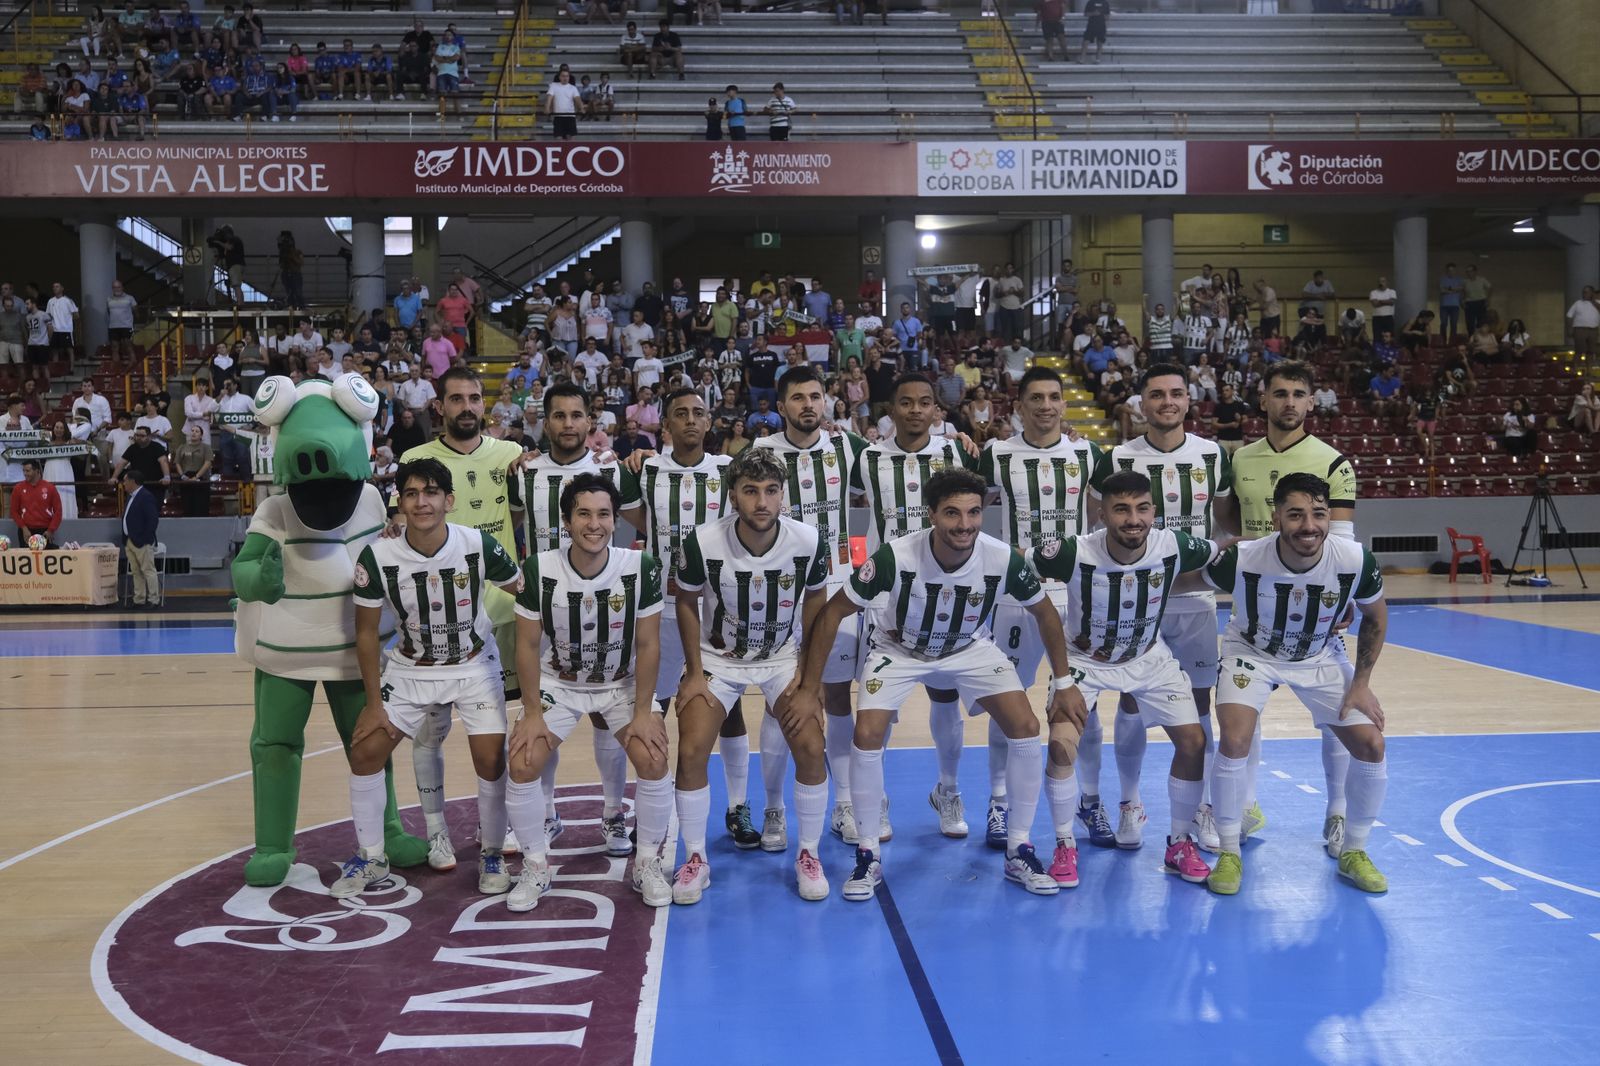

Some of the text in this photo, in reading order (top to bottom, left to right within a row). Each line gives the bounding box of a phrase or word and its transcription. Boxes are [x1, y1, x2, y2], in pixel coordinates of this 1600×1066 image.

[90, 146, 307, 159] PALACIO MUNICIPAL DEPORTES
[1031, 149, 1161, 166] PATRIMONIO
[1490, 148, 1600, 171] IMDECO
[463, 146, 625, 177] IMDECO
[752, 154, 831, 168] AYUNTAMIENTO
[1165, 158, 1177, 166] LA
[1300, 154, 1382, 171] Diputación
[74, 164, 329, 193] VISTA ALEGRE
[753, 168, 820, 184] DE CÓRDOBA
[926, 174, 1015, 190] CÓRDOBA
[1031, 169, 1178, 190] HUMANIDAD
[1300, 172, 1383, 184] de Córdoba
[1488, 176, 1524, 184] Municipal
[1536, 176, 1570, 184] Deportes
[416, 182, 624, 195] Instituto Municipal de Deportes Córdoba
[762, 232, 773, 246] D
[1272, 229, 1282, 241] E
[224, 414, 259, 422] CÓRDO
[56, 446, 84, 454] FUTSAL
[2, 552, 73, 577] uatec
[1008, 626, 1021, 649] 8
[873, 656, 892, 673] 7
